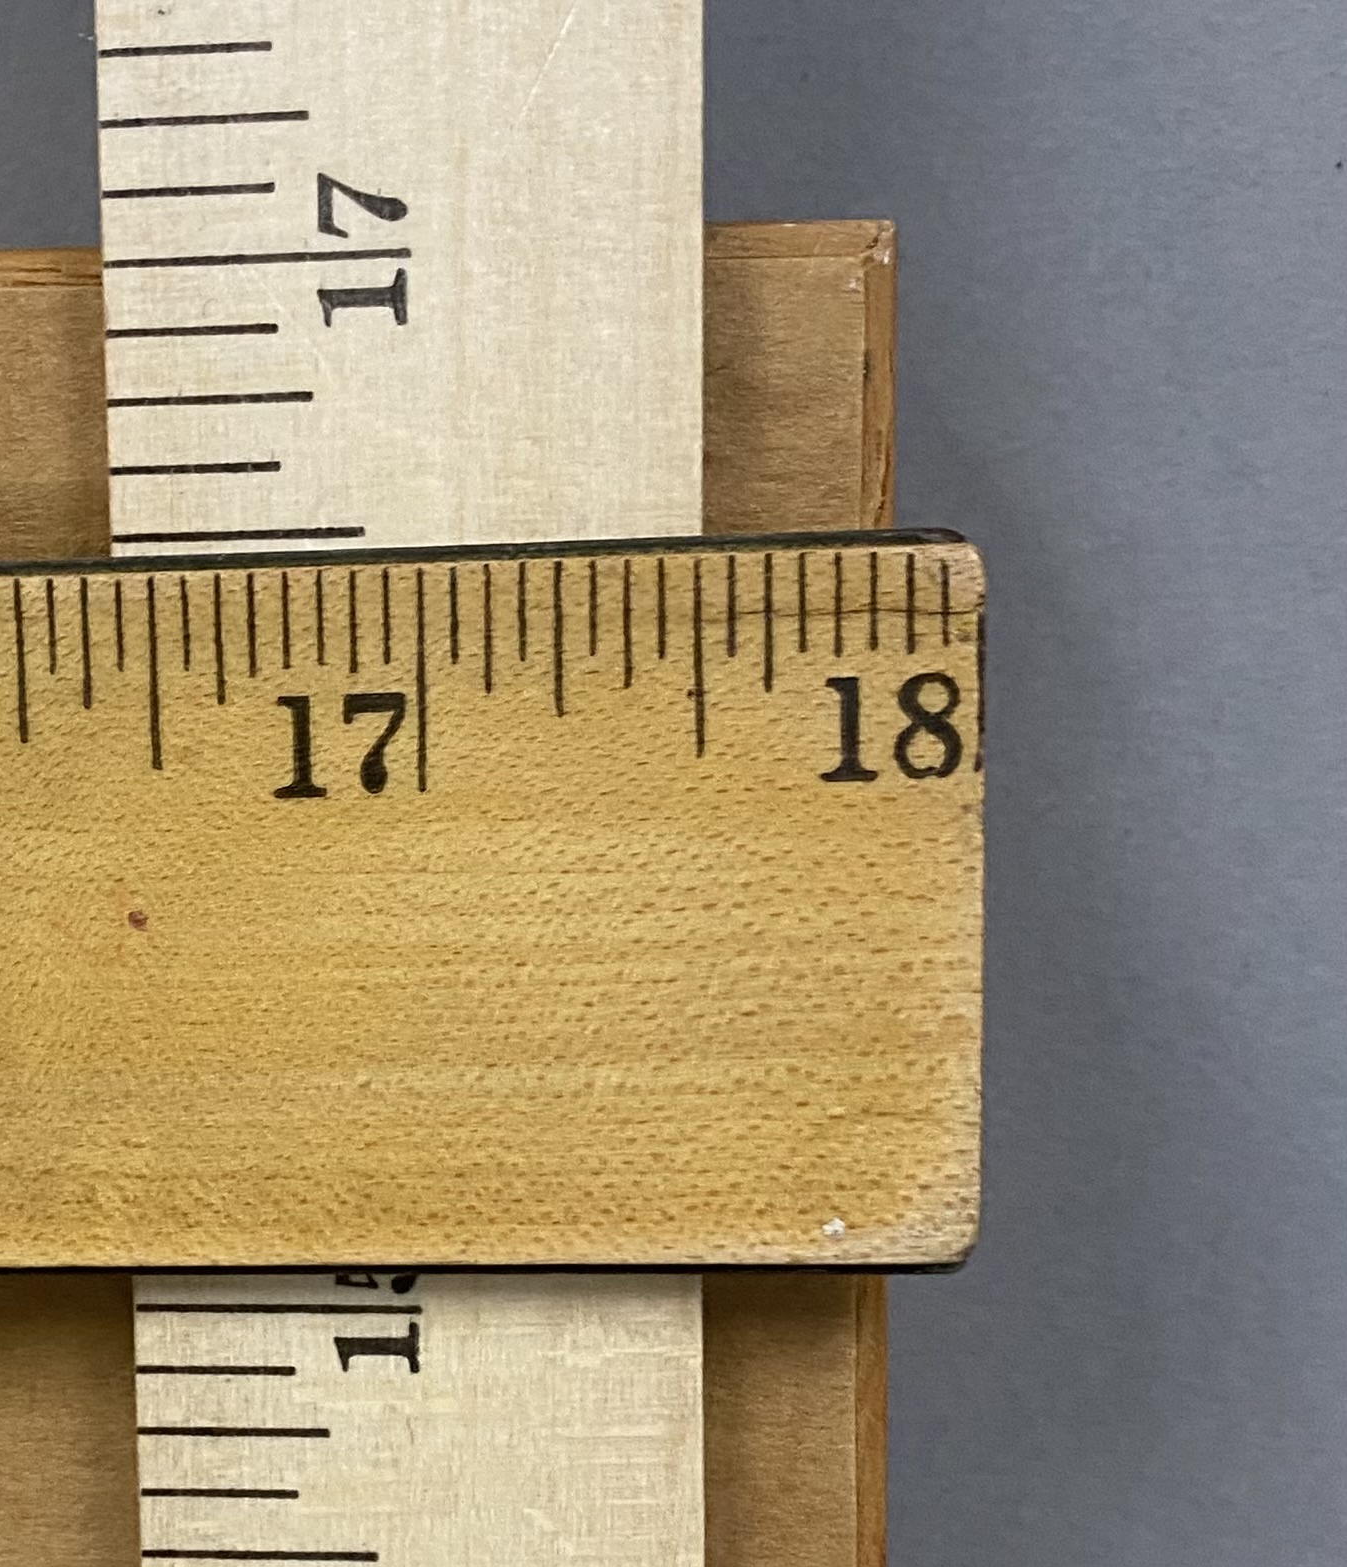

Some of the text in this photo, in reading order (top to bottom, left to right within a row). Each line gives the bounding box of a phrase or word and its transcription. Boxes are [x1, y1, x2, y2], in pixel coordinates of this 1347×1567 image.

[317, 172, 409, 327] 17
[273, 692, 407, 799] 17
[819, 671, 963, 783] 18
